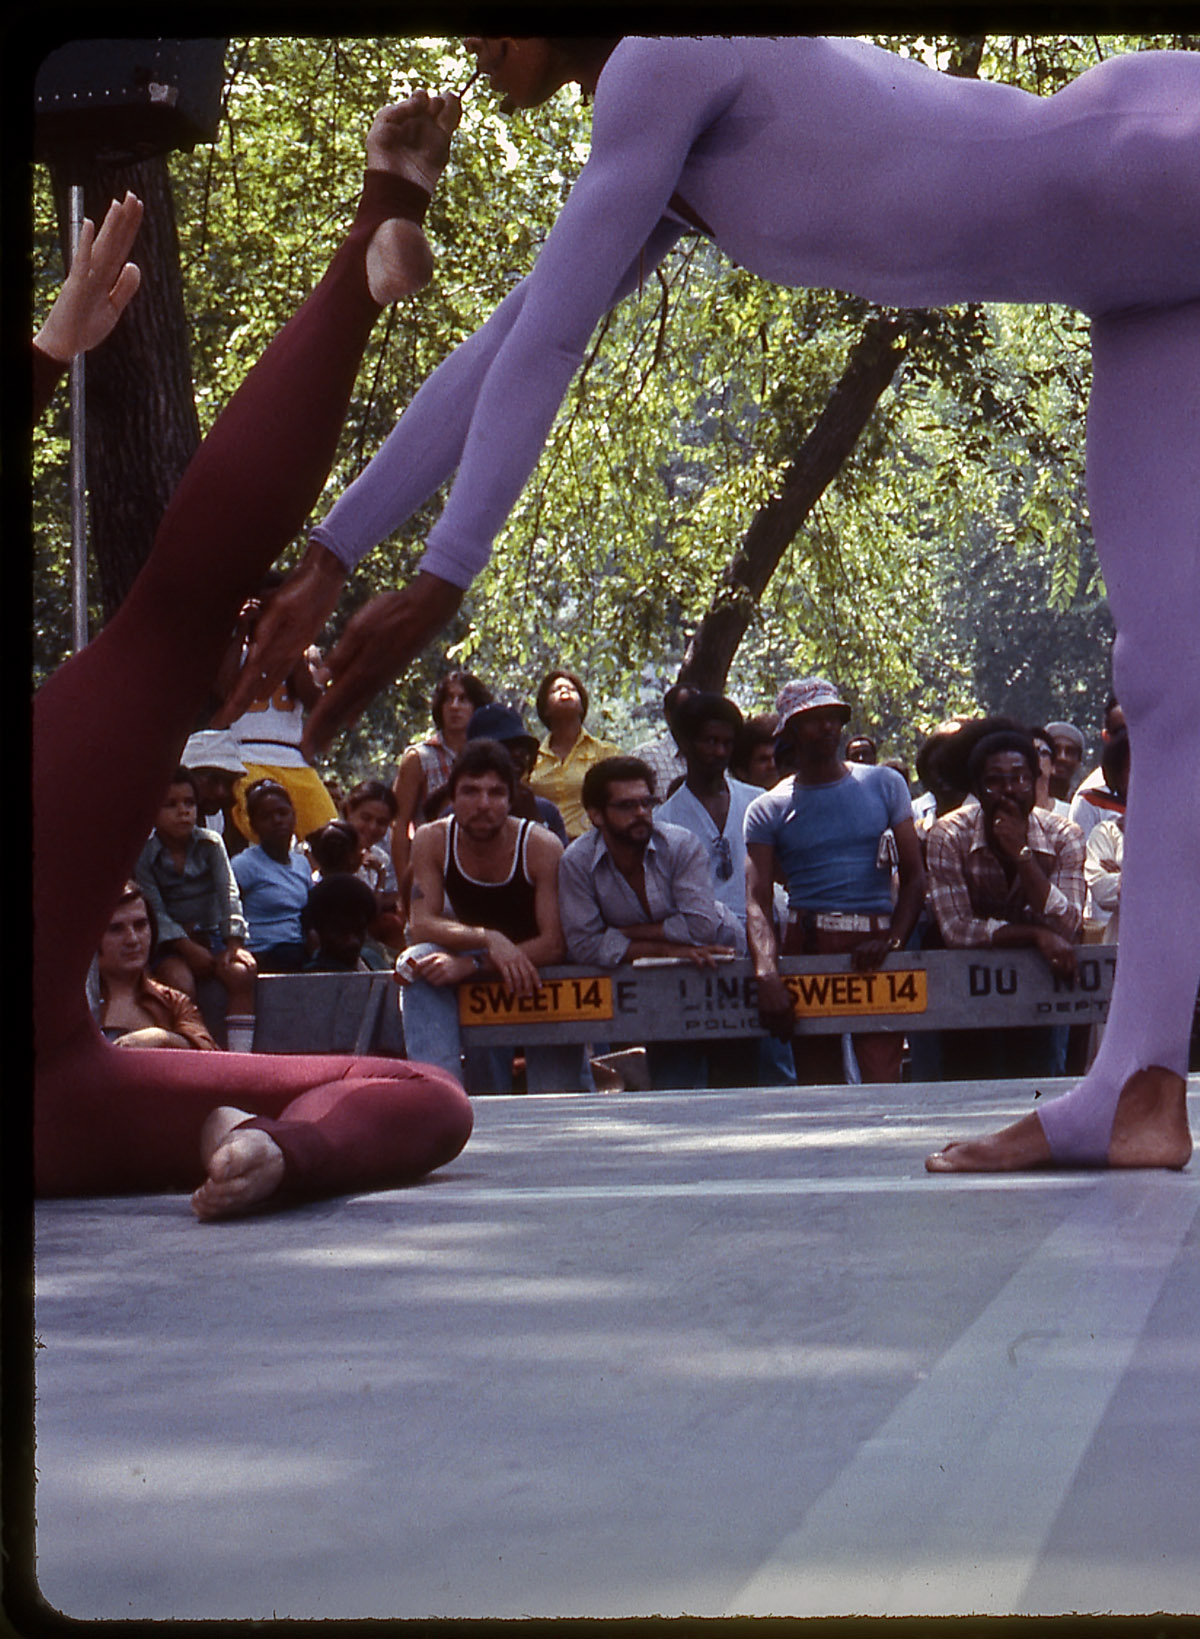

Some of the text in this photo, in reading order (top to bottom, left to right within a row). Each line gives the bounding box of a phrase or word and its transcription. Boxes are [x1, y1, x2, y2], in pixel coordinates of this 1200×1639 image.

[469, 979, 603, 1015] SWEET 14
[785, 973, 918, 1006] SWEET 14
[685, 1017, 761, 1031] POLIC
